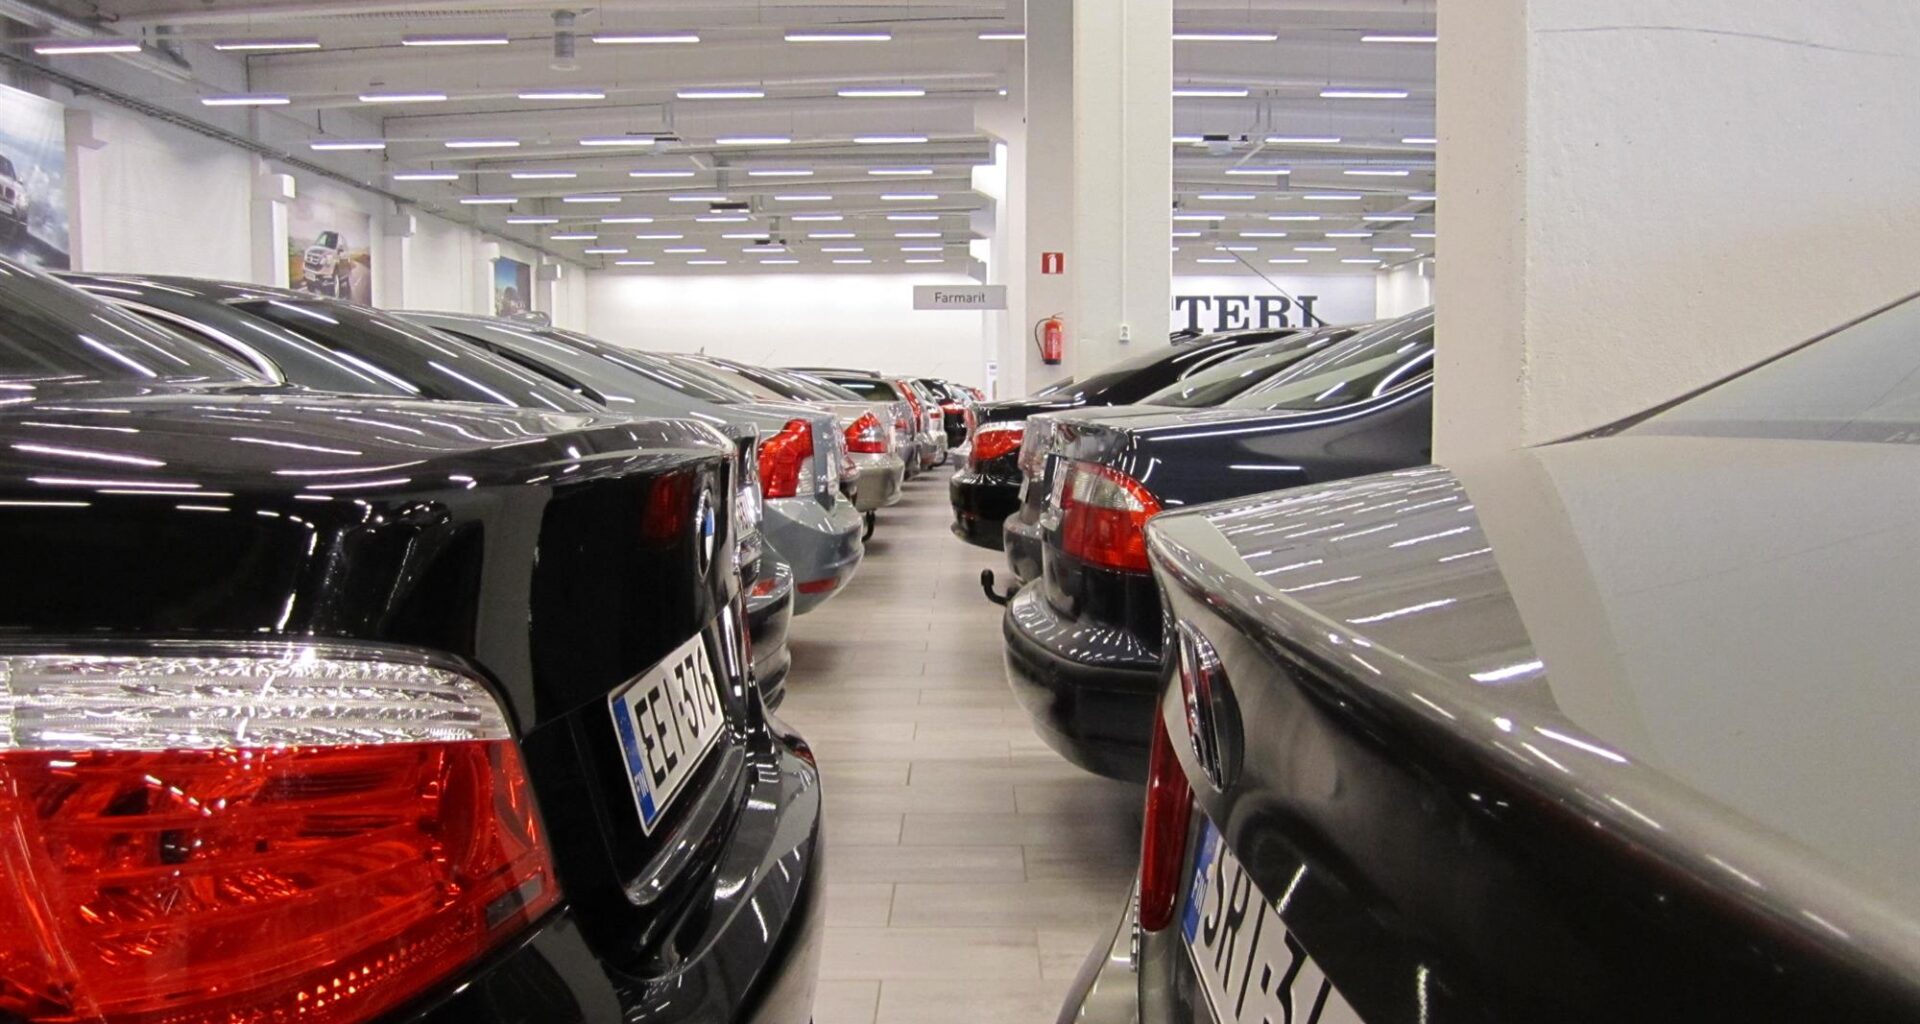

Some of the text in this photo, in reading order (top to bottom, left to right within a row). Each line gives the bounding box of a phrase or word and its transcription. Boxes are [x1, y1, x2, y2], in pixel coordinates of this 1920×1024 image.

[934, 292, 985, 303] Farmarit
[1171, 295, 1318, 333] TERI
[634, 646, 716, 789] EEI-376
